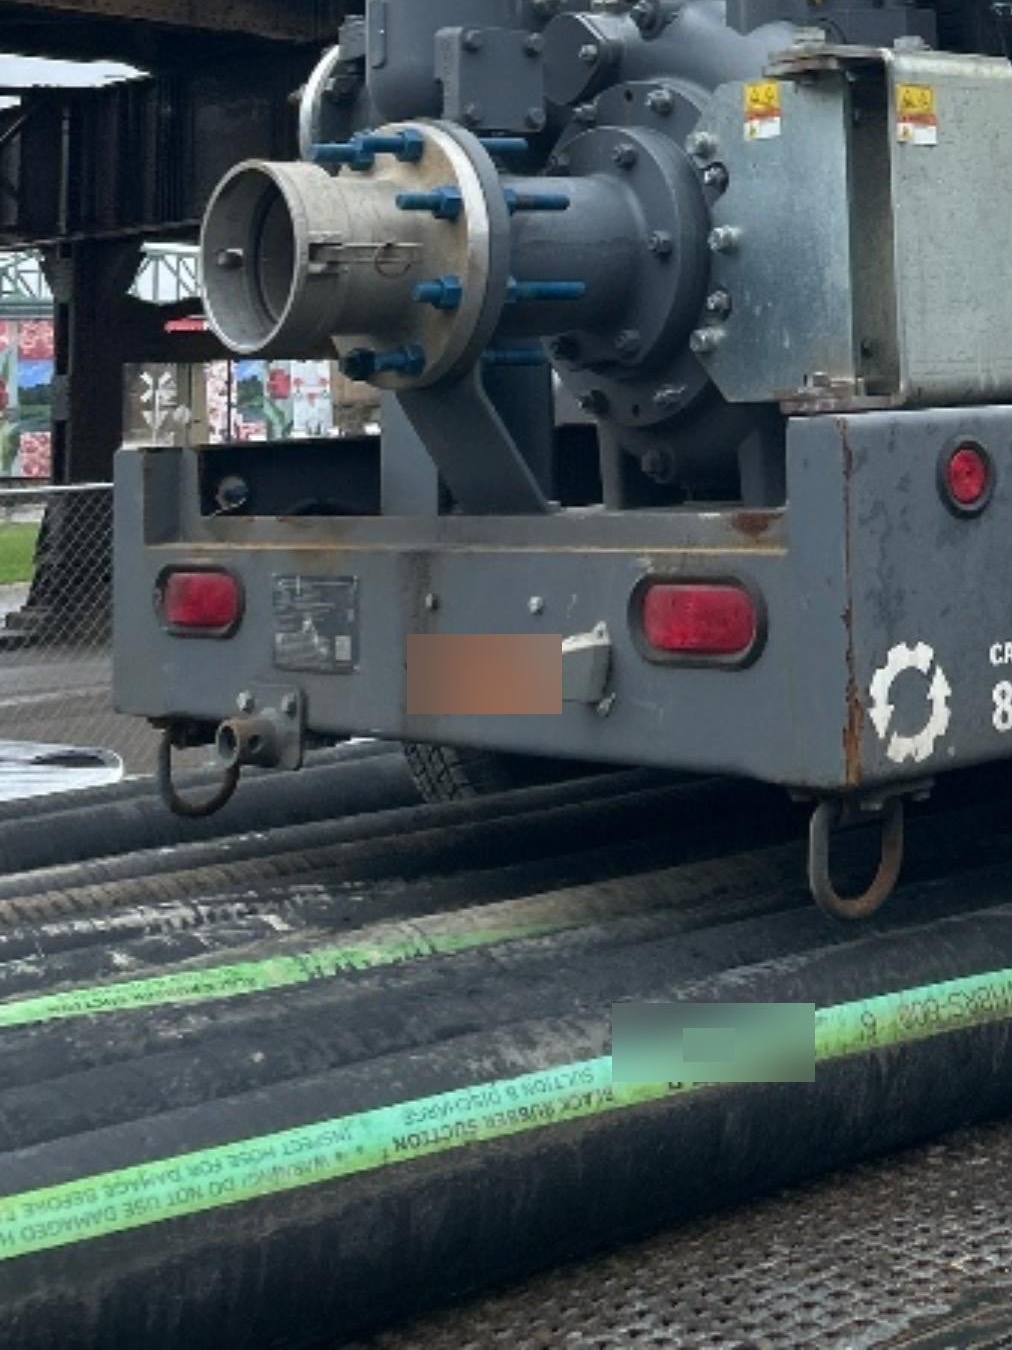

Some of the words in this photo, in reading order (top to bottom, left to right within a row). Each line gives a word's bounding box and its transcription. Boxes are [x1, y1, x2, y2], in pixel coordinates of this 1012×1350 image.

[483, 1102, 556, 1129] RUBBER
[393, 1119, 478, 1151] SUCTION
[185, 1159, 222, 1175] FOR
[226, 1145, 276, 1166] HOSE
[102, 1169, 181, 1198] DAMAGE
[209, 1177, 235, 1194] DO
[22, 1187, 98, 1218] BEFORE
[121, 1197, 160, 1216] USE
[167, 1187, 203, 1206] NOT
[20, 1205, 117, 1243] DAMAGED
